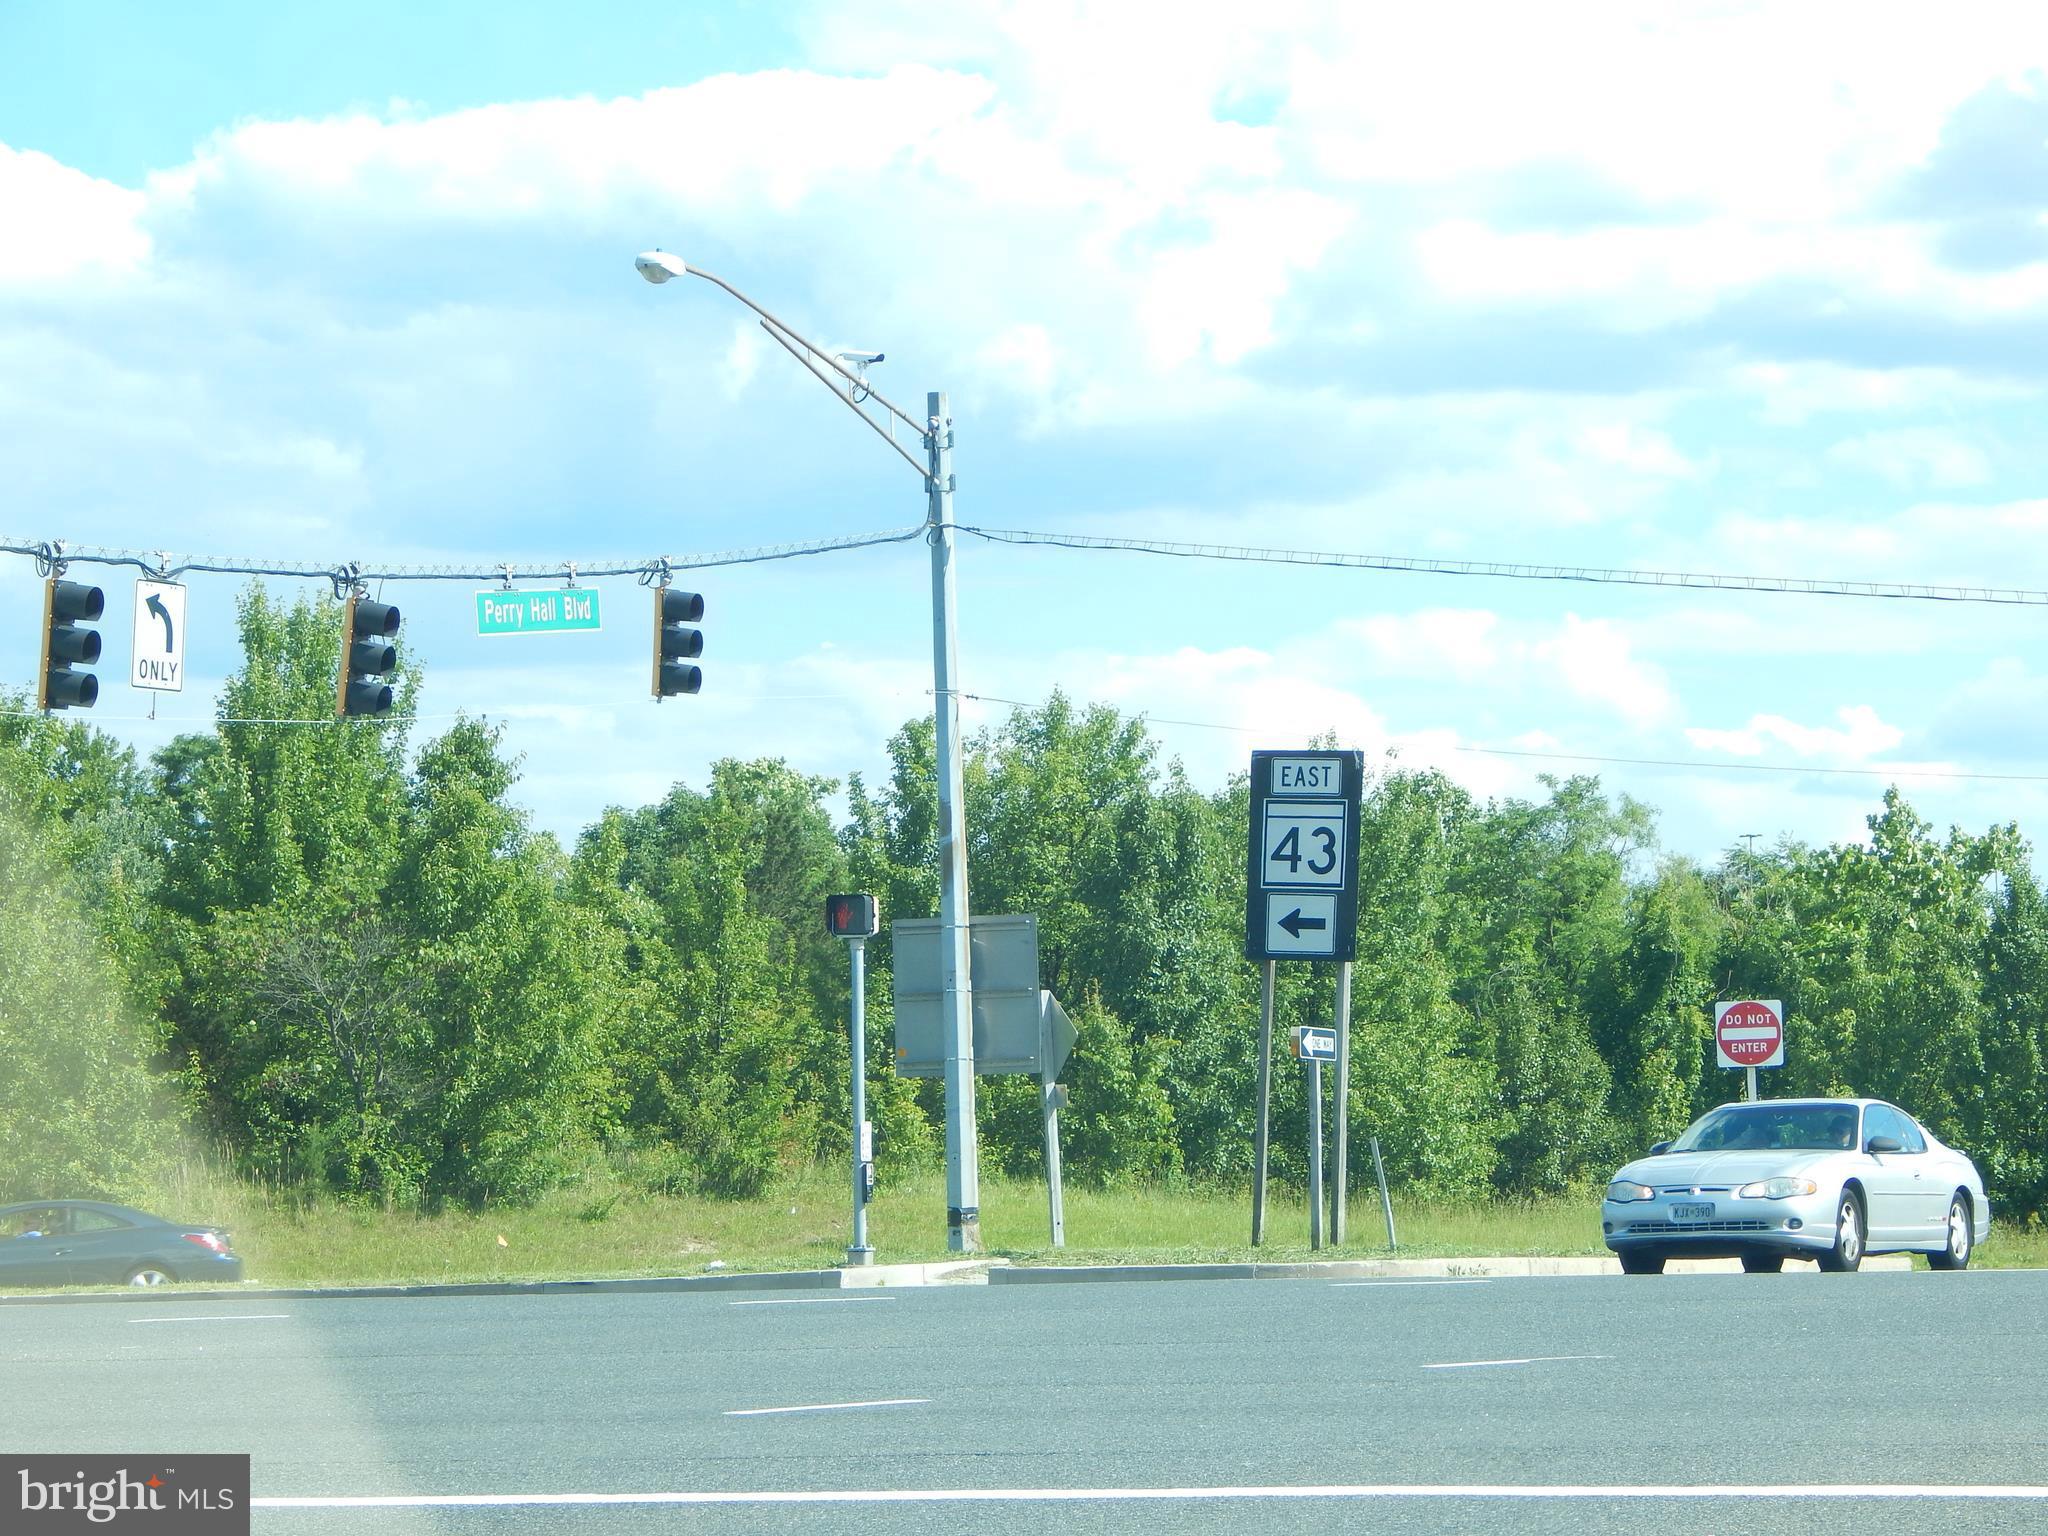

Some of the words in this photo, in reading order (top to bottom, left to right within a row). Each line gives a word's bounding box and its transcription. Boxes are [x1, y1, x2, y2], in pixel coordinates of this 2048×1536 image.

[484, 599, 524, 628] Perry
[530, 597, 556, 622] Hall
[564, 595, 592, 620] Blvd
[139, 658, 179, 682] ONLY
[1281, 765, 1332, 787] EAST
[1270, 826, 1337, 875] 43
[1725, 1014, 1742, 1025] DO
[1747, 1013, 1772, 1025] NOT
[1731, 1042, 1768, 1053] ENTER
